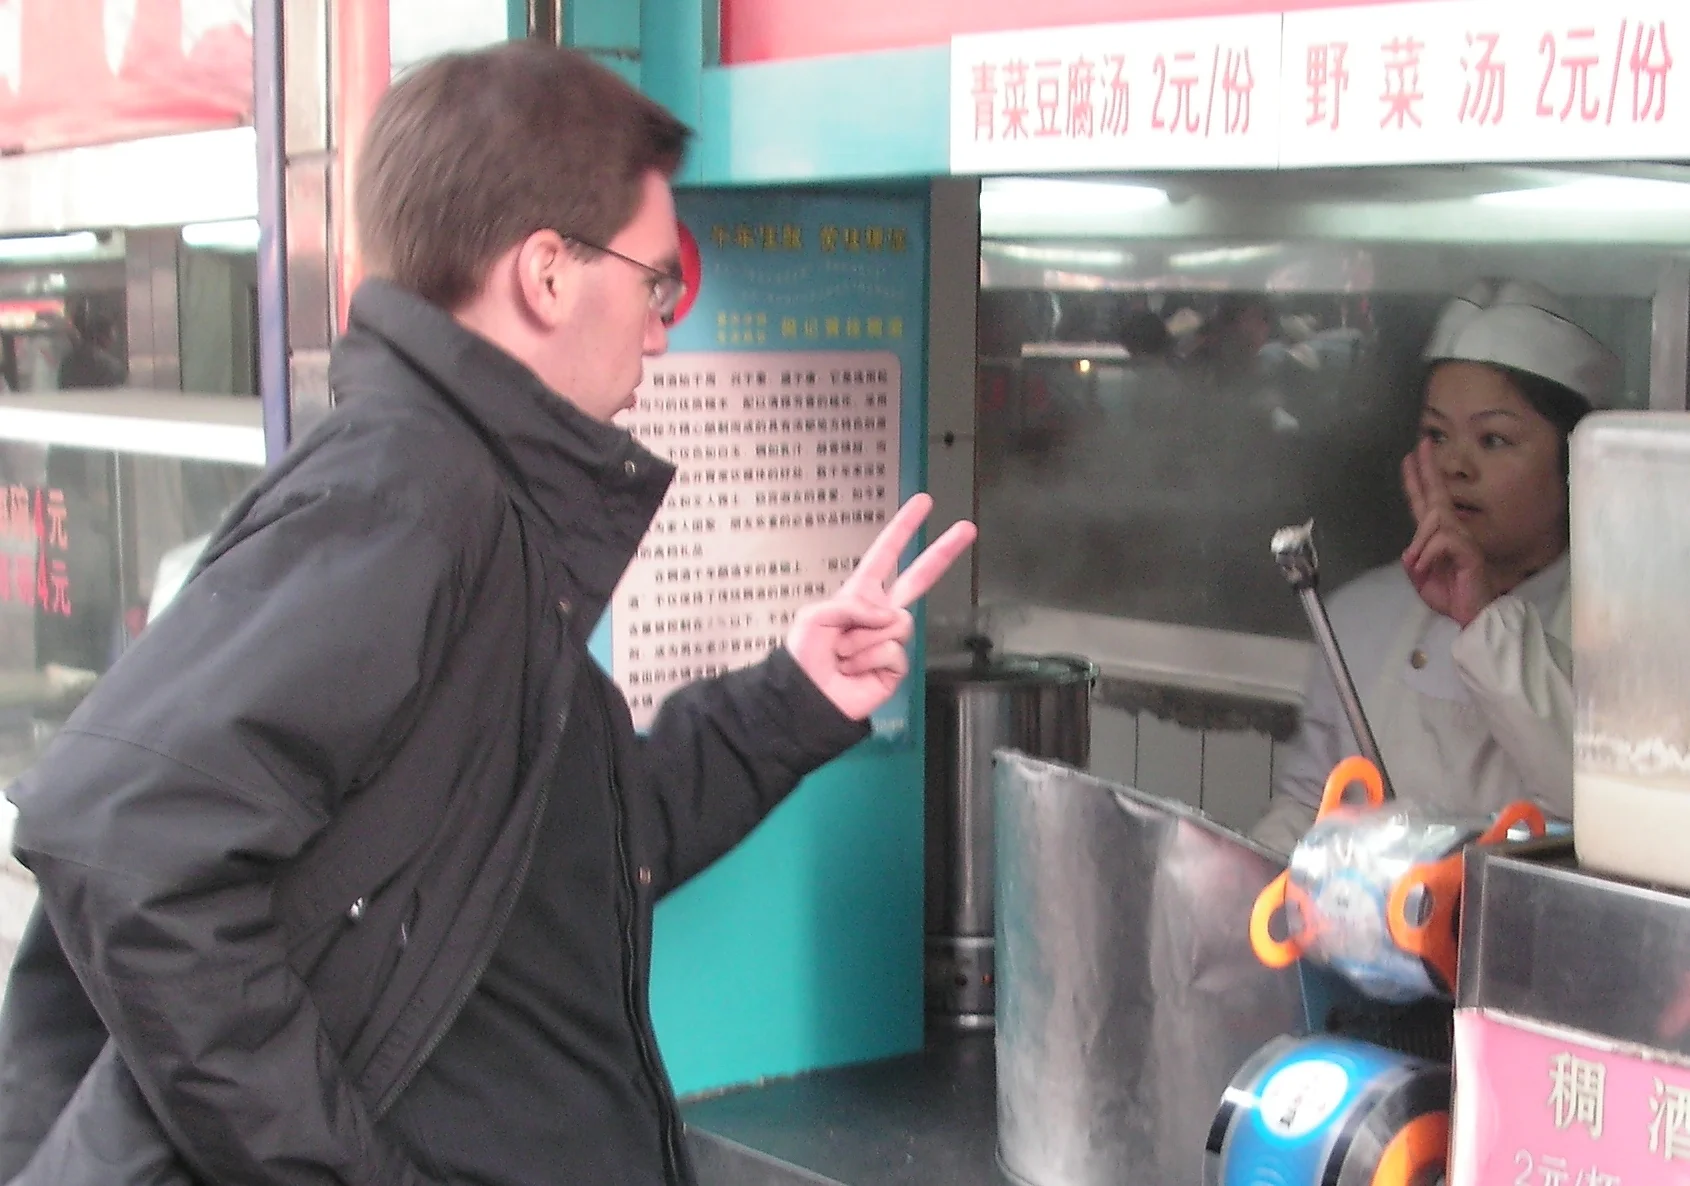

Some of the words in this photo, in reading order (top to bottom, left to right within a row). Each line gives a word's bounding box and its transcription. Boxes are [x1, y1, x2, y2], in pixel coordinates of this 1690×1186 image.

[970, 55, 1129, 141] 青菜豆腐汤
[1151, 44, 1256, 137] 2元/份
[1306, 32, 1506, 131] 野菜汤
[1537, 19, 1674, 126] 2元/份
[1547, 1052, 1690, 1162] 稠酒
